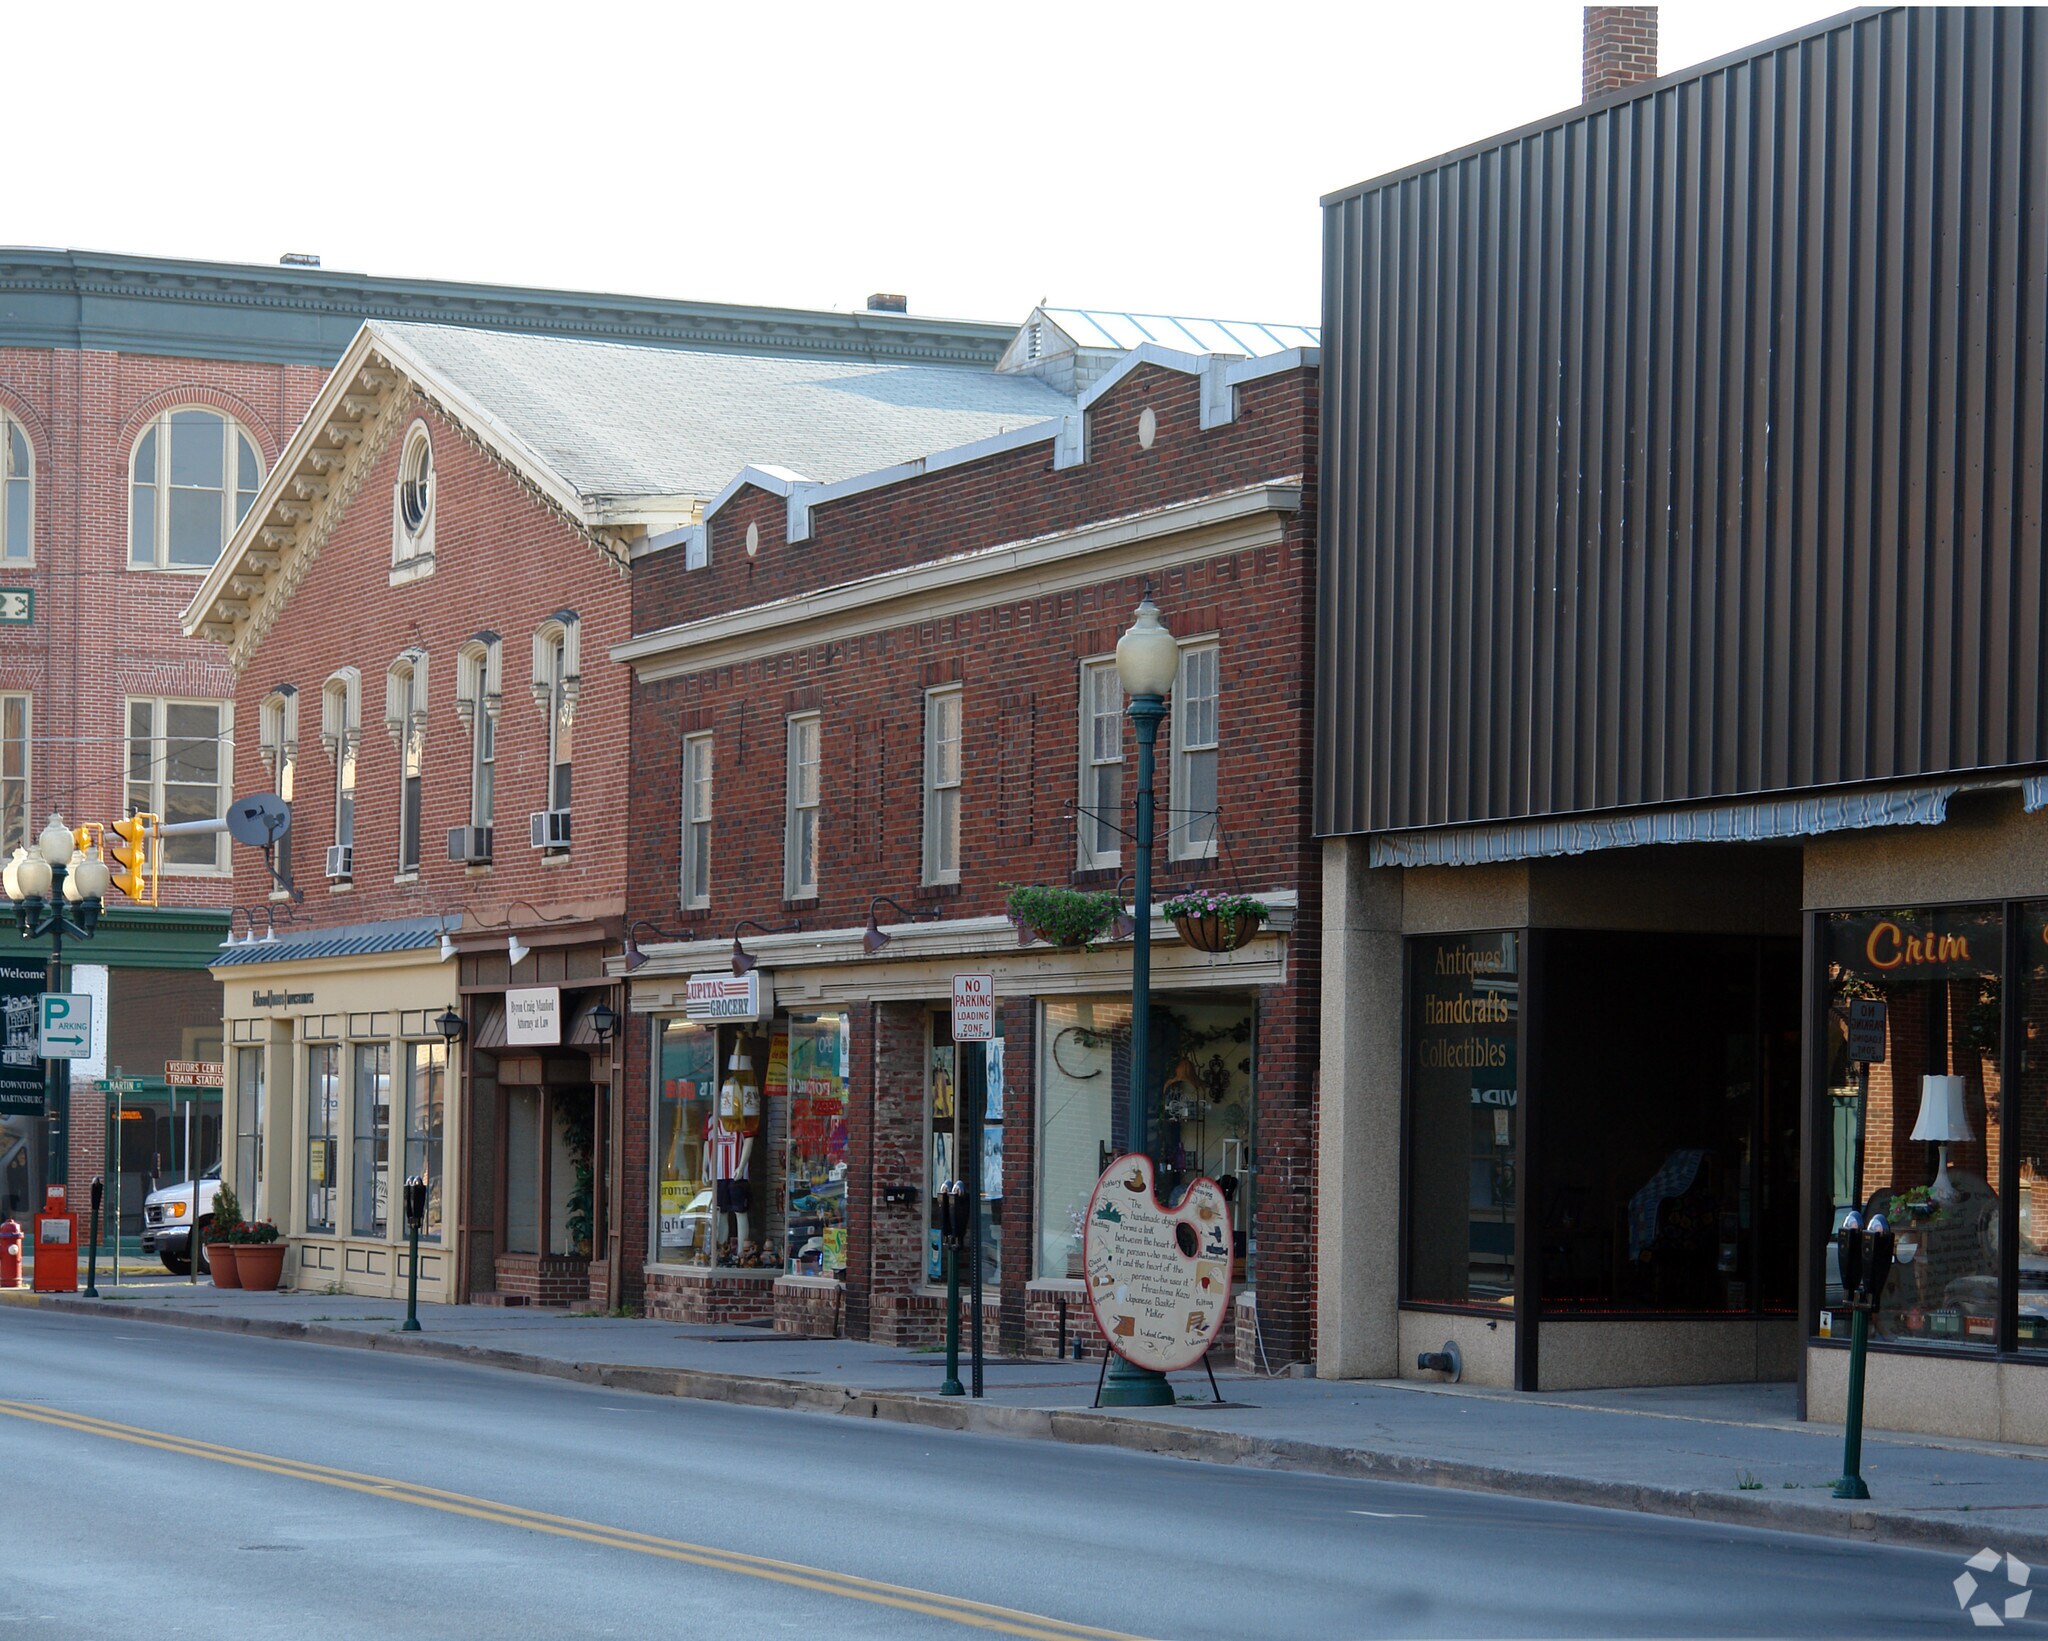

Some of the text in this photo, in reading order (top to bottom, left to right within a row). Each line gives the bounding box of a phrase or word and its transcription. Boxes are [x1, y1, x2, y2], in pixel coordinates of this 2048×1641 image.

[1866, 920, 1971, 970] Crim
[1435, 944, 1501, 982] Antiques
[0, 967, 46, 979] Welcome
[686, 981, 724, 999] LUPITA'S
[965, 980, 981, 992] NO
[710, 998, 749, 1016] GROCERY
[955, 994, 991, 1007] PARKING
[1425, 989, 1508, 1024] Handcrafts
[957, 1011, 990, 1021] LOADING
[963, 1023, 984, 1033] ZONE
[1420, 1037, 1506, 1068] Collectibles
[170, 1062, 200, 1073] VISITORS
[0, 1080, 44, 1090] DOWNTOWN
[109, 1081, 134, 1090] MARTIN
[170, 1074, 193, 1084] TRAIN
[0, 1093, 43, 1104] MARTINSBURG
[1102, 1179, 1121, 1189] Pottery
[1130, 1211, 1160, 1224] handmade
[1120, 1221, 1137, 1233] forms
[1143, 1225, 1155, 1235] link
[1115, 1232, 1143, 1245] between
[1143, 1236, 1152, 1246] the
[1153, 1238, 1170, 1249] heart
[1115, 1245, 1178, 1262] the person who made
[1116, 1257, 1184, 1274] it and the heart of the
[1131, 1273, 1151, 1283] person
[1153, 1275, 1168, 1283] who
[1125, 1294, 1176, 1309] Japanese Basket
[1145, 1307, 1165, 1319] Maker
